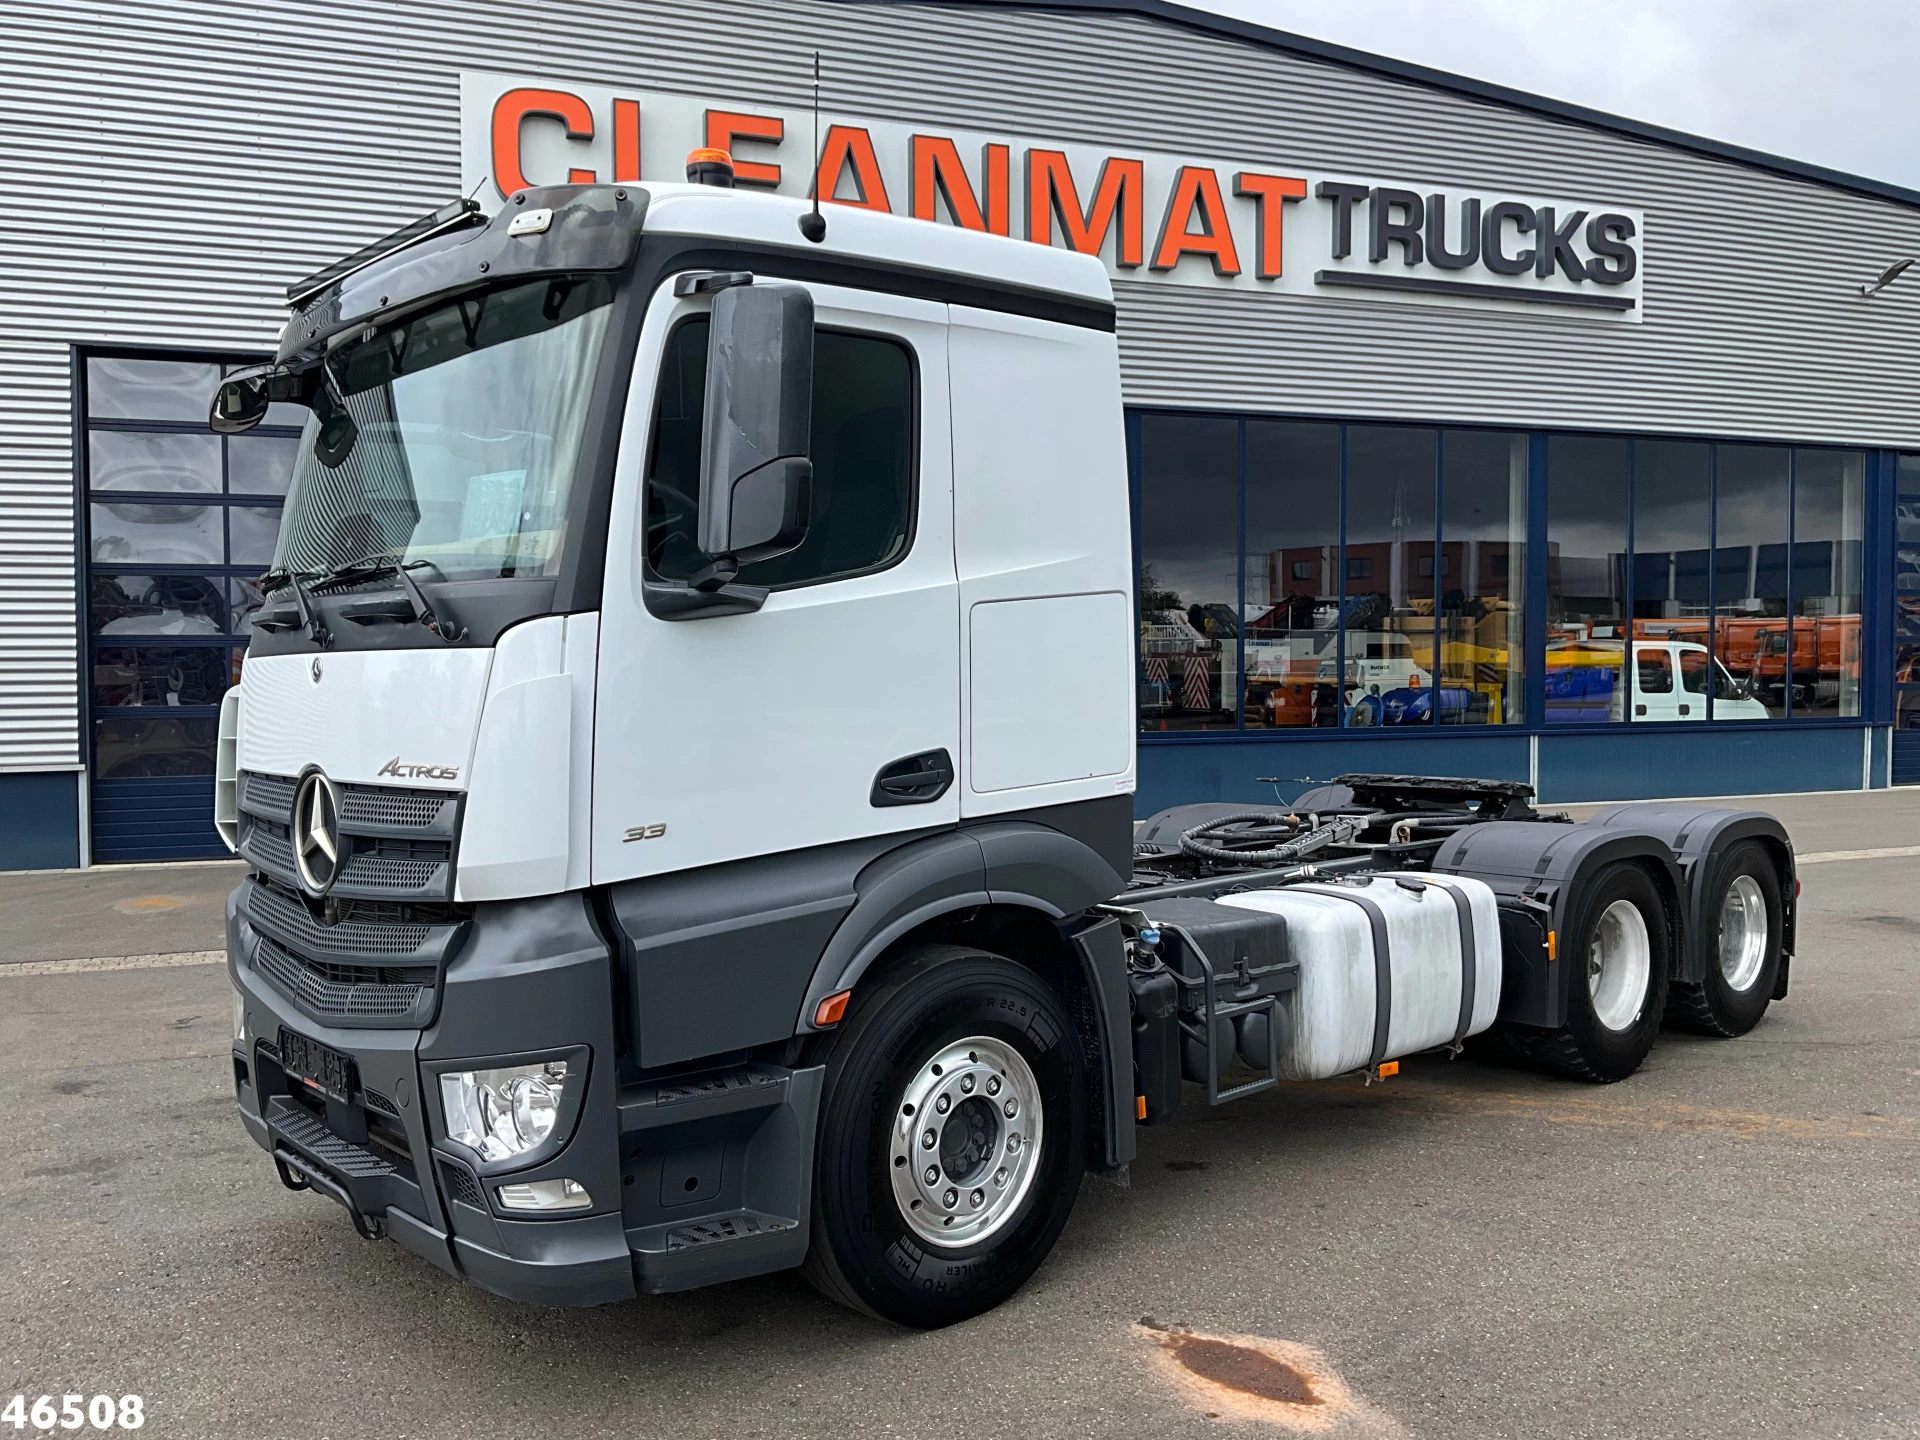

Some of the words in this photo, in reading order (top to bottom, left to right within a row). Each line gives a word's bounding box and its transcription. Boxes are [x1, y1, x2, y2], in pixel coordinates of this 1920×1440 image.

[491, 87, 1307, 280] CLEANMAT
[1315, 180, 1637, 285] TRUCKS
[622, 822, 667, 843] 33
[987, 998, 995, 1008] R
[1000, 999, 1028, 1017] 22.5
[898, 1256, 911, 1271] HL
